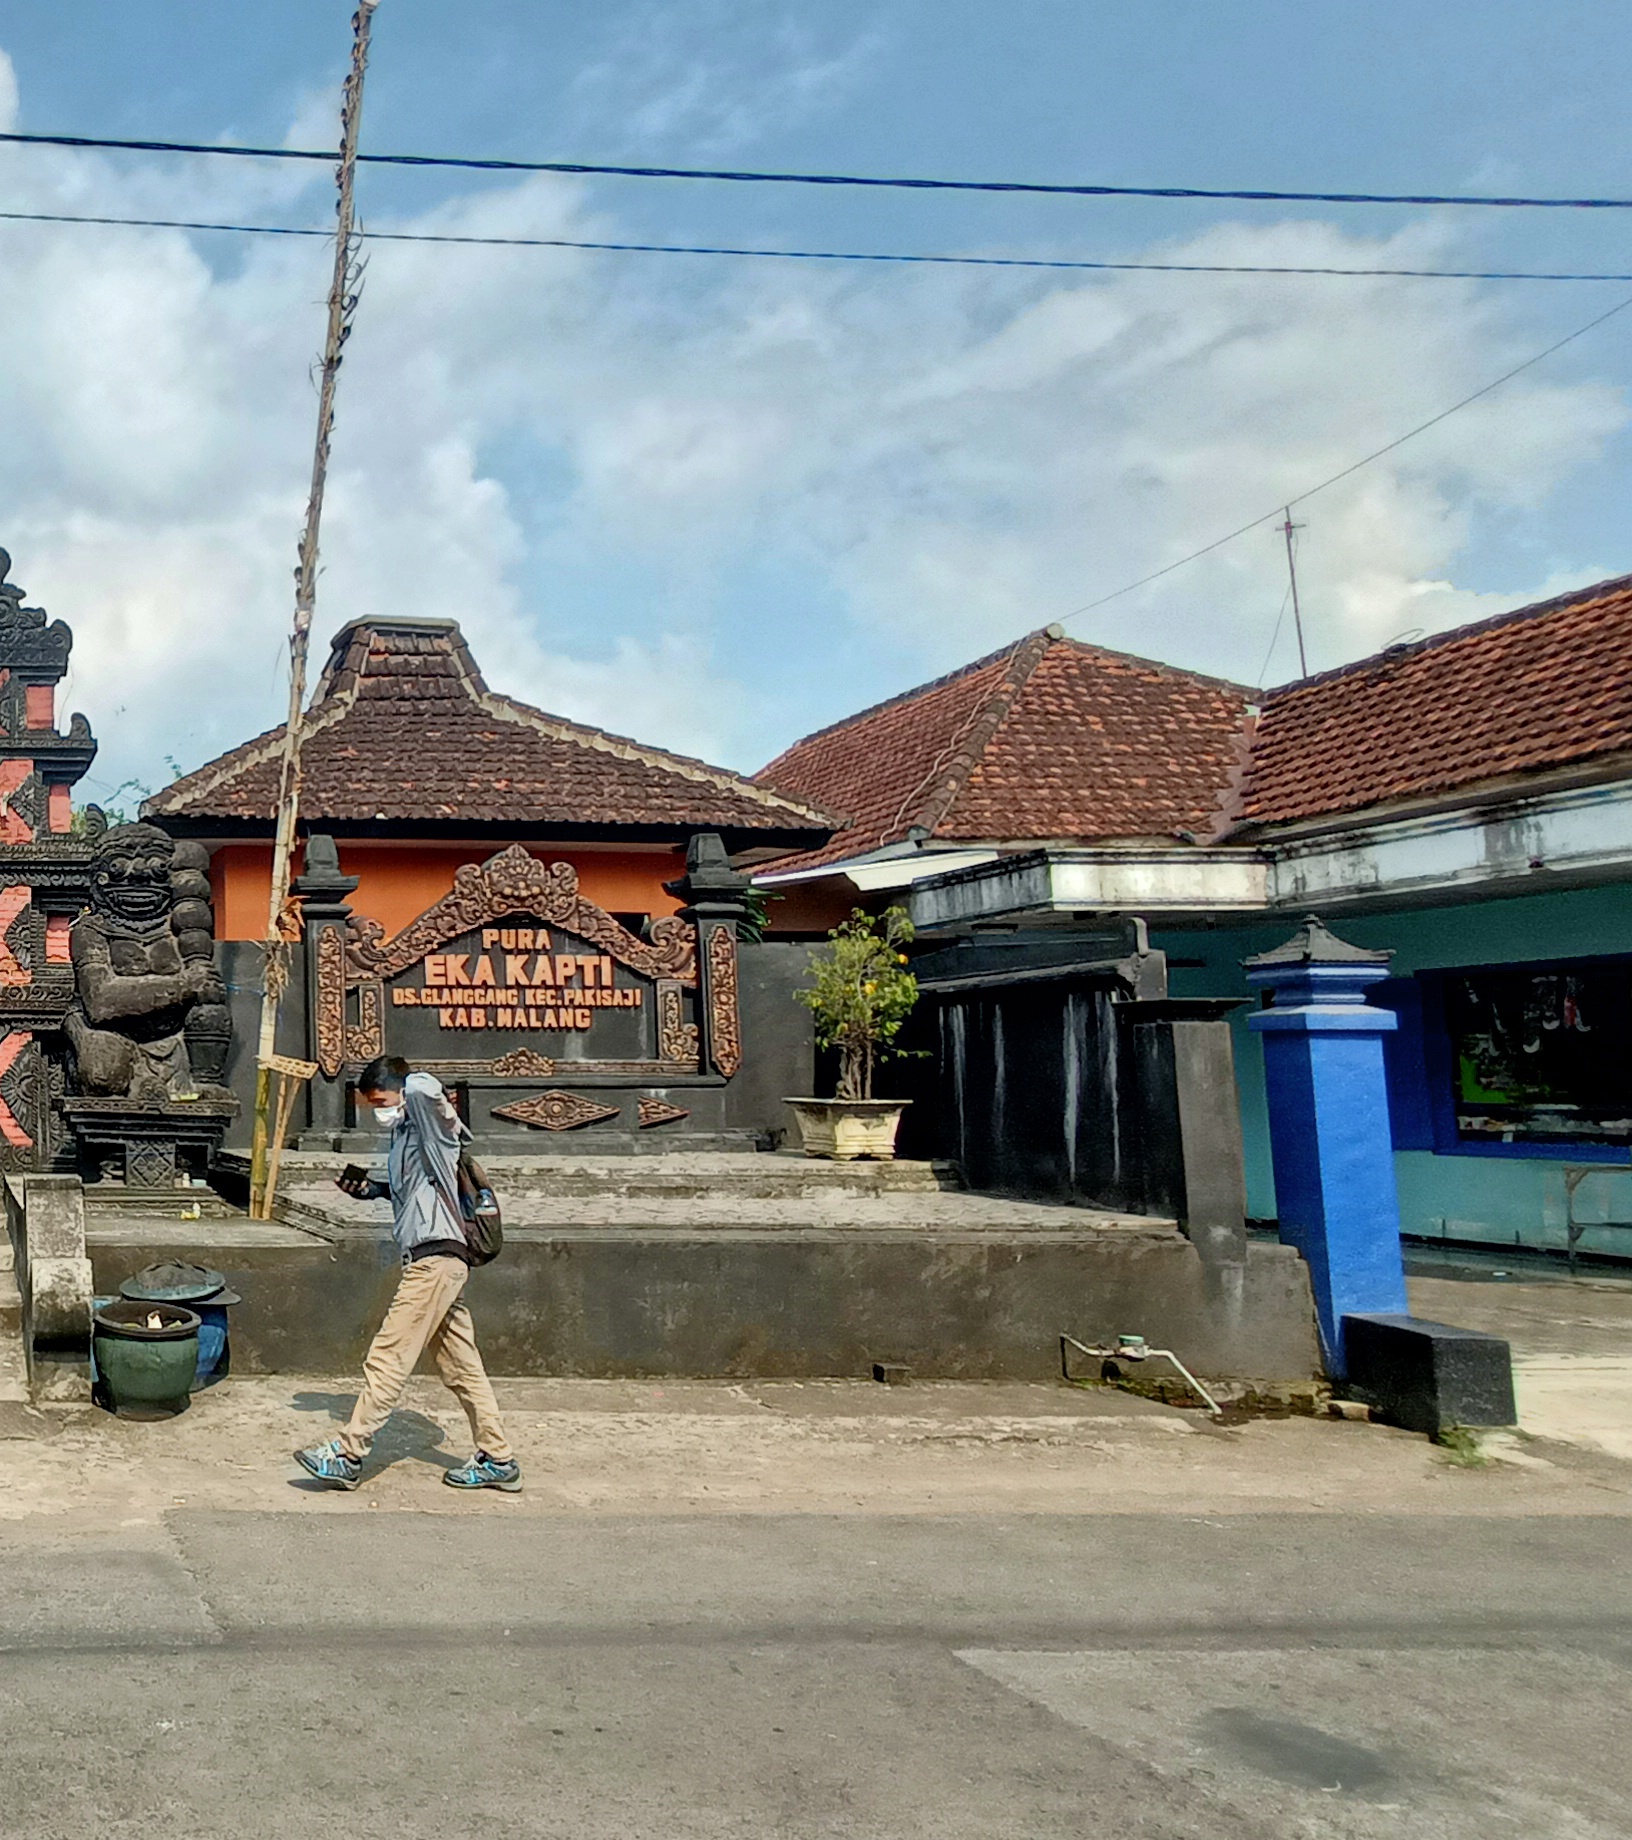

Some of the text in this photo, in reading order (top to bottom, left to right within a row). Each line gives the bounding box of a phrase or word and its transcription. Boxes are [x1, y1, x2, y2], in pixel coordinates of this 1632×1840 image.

[482, 928, 552, 949] PURA
[424, 954, 613, 987] EKA KAPTI
